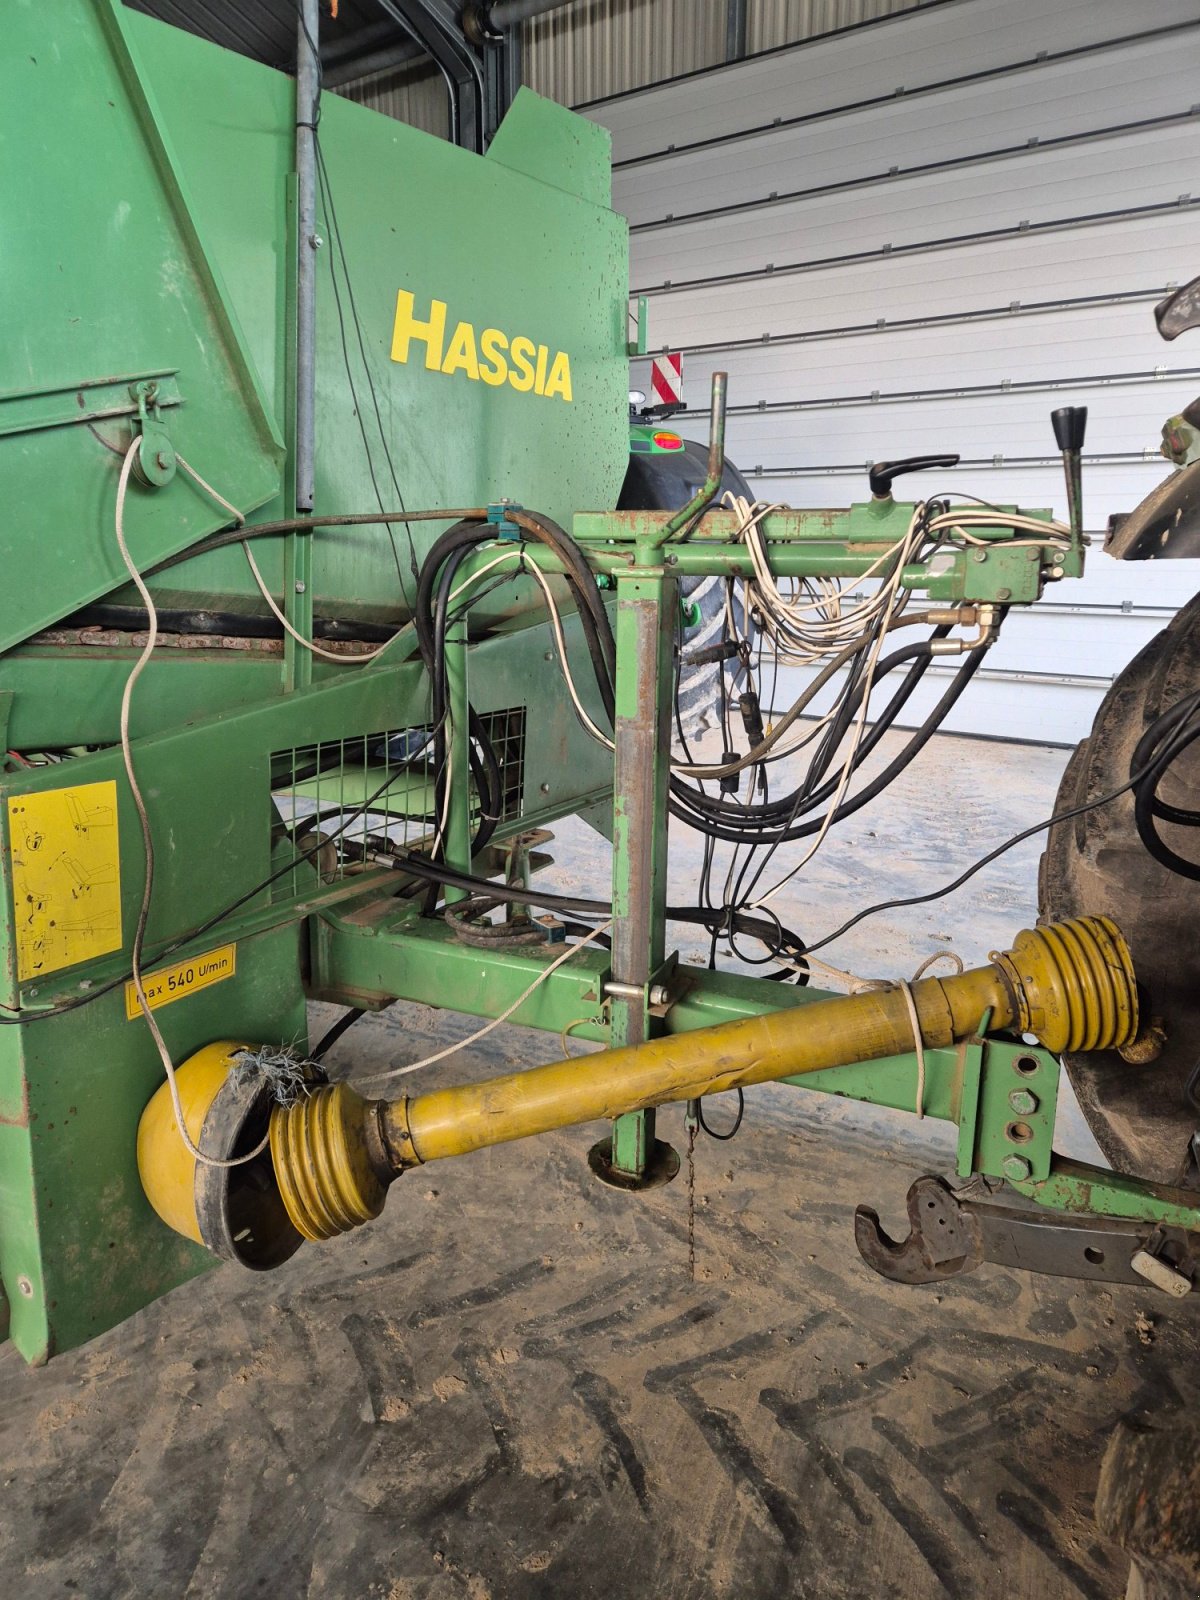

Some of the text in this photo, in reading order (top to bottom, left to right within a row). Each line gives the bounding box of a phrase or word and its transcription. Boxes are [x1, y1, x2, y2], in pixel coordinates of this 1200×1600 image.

[390, 288, 573, 402] HASSIA
[168, 969, 194, 991] 540
[198, 958, 228, 977] U/min
